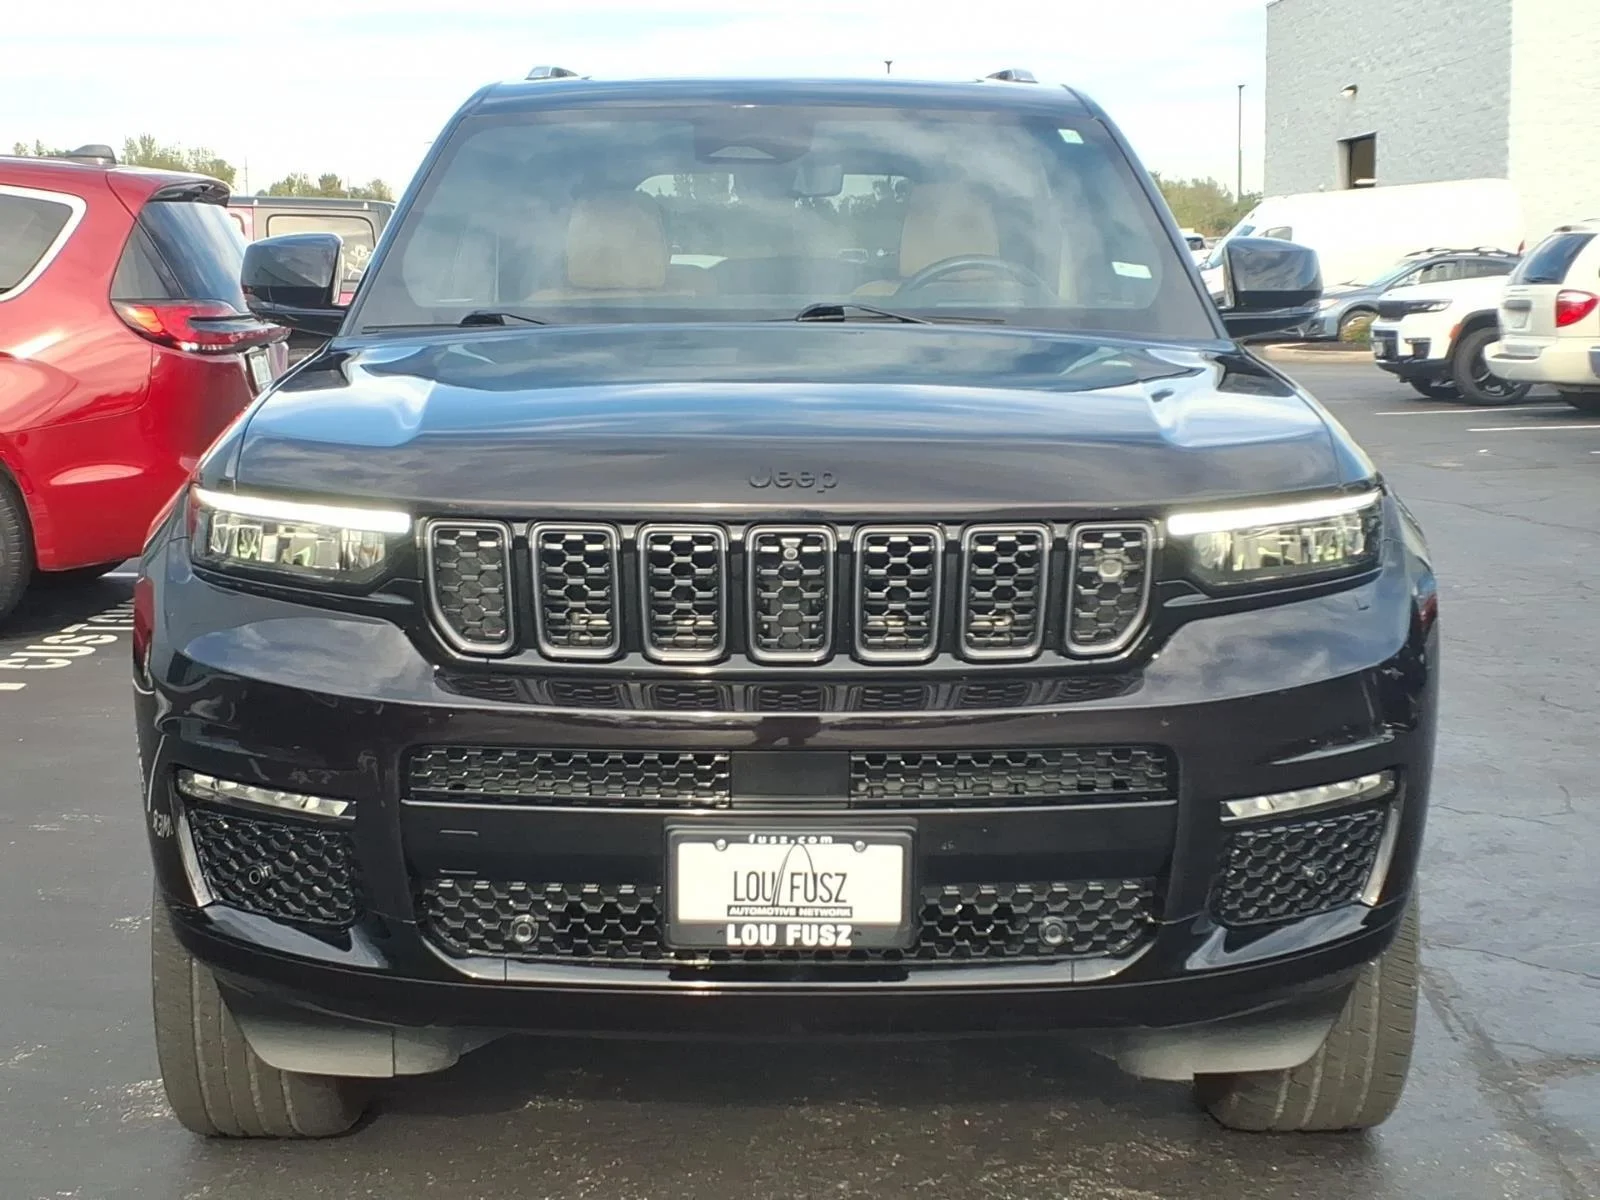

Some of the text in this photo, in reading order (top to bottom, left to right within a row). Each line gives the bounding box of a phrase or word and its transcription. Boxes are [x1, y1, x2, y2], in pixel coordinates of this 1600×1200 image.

[748, 466, 838, 494] Jeep
[748, 832, 833, 844] fusz.com
[733, 870, 848, 903] LOU FUSZ
[729, 906, 852, 917] AUTOMOTIVE NETWORK
[726, 923, 852, 946] LOU FUSZ
